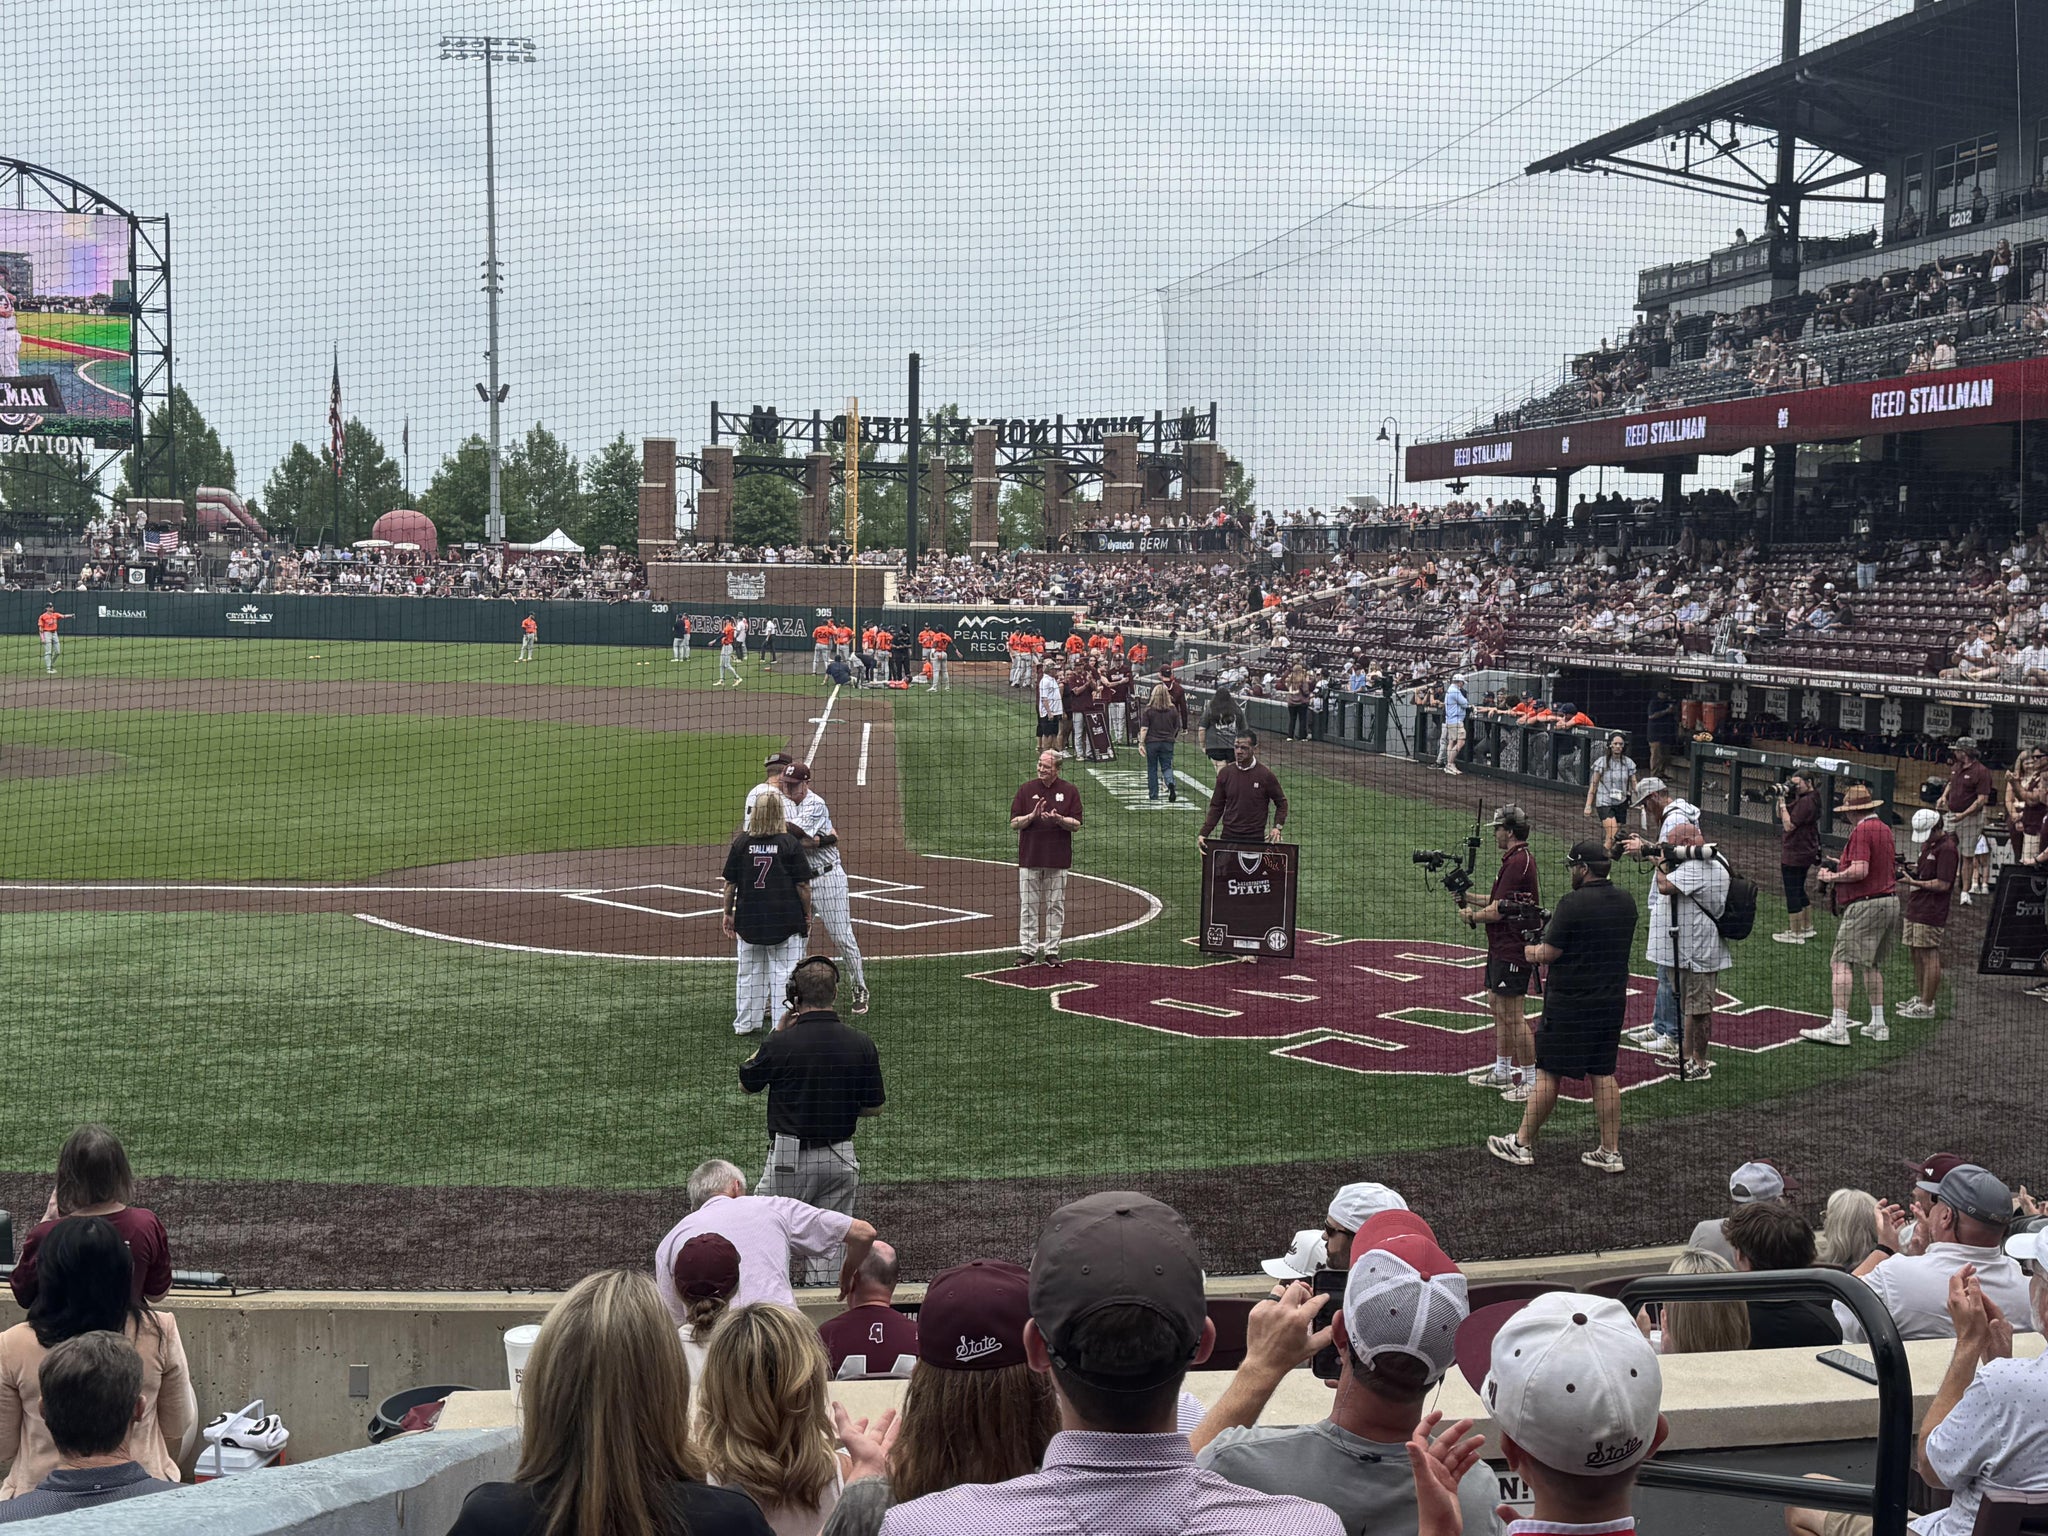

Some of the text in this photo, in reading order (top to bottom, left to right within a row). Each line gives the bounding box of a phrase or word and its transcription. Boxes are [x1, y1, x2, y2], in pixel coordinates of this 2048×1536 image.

[1949, 210, 1972, 228] C202
[1871, 379, 1993, 419] REED STALLMAN
[1625, 420, 1706, 447] REED STALLMAN
[1454, 442, 1512, 467] REED STALLMAN
[1140, 537, 1169, 550] BERM
[259, 612, 273, 620] SKY
[651, 603, 669, 613] 330
[815, 608, 832, 617] 305
[748, 617, 808, 637] PLAZA
[953, 630, 997, 640] PEARL
[970, 642, 1008, 652] RESO
[748, 844, 779, 854] STALLMAN
[753, 856, 773, 889] 7
[1228, 879, 1271, 895] STATE
[1270, 932, 1286, 949] SEC
[955, 1335, 1003, 1362] State
[1584, 1436, 1643, 1468] State
